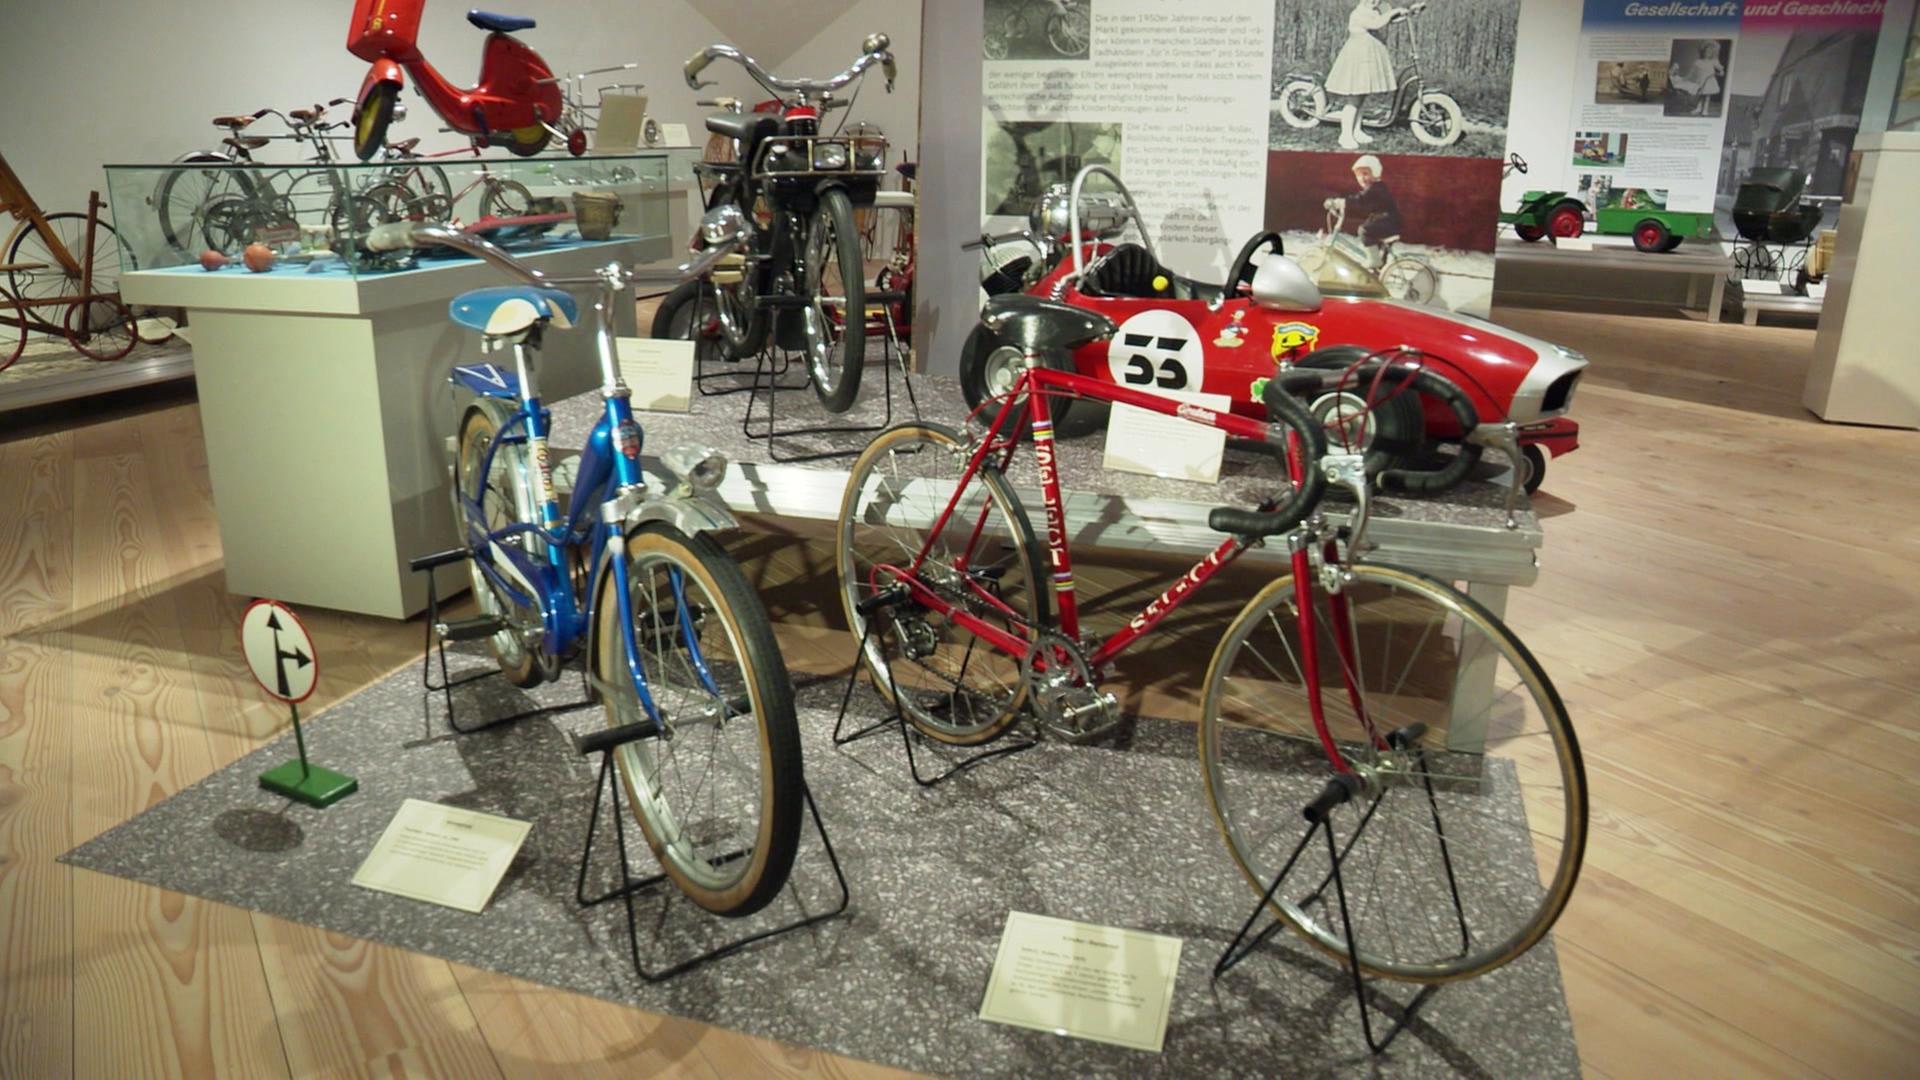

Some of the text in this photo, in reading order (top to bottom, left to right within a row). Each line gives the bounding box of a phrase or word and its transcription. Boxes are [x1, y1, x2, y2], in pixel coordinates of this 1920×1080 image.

[1624, 1, 1738, 16] Gesellschaft
[1743, 1, 1782, 16] und
[1124, 333, 1188, 390] 33
[1035, 446, 1062, 567] SELECT
[1130, 546, 1221, 633] SELECT
